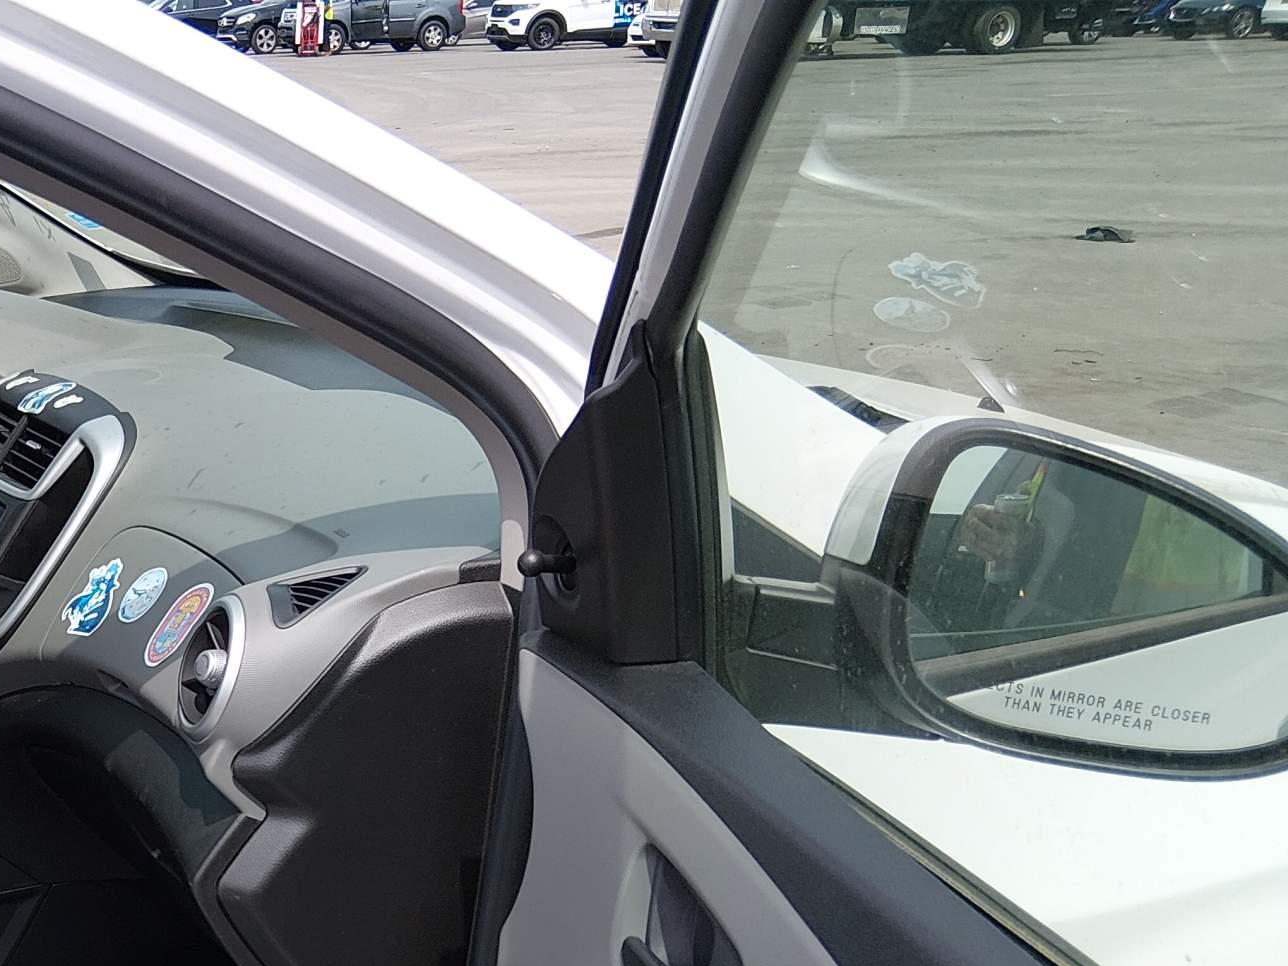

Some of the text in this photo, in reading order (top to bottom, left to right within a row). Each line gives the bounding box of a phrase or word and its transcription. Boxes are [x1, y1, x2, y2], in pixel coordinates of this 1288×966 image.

[1004, 696, 1153, 732] THAN THEY APPEAR
[1030, 685, 1045, 699] IN
[1049, 688, 1106, 709] MIRROR
[1112, 698, 1144, 714] ARE
[1151, 704, 1211, 725] CLOSER
